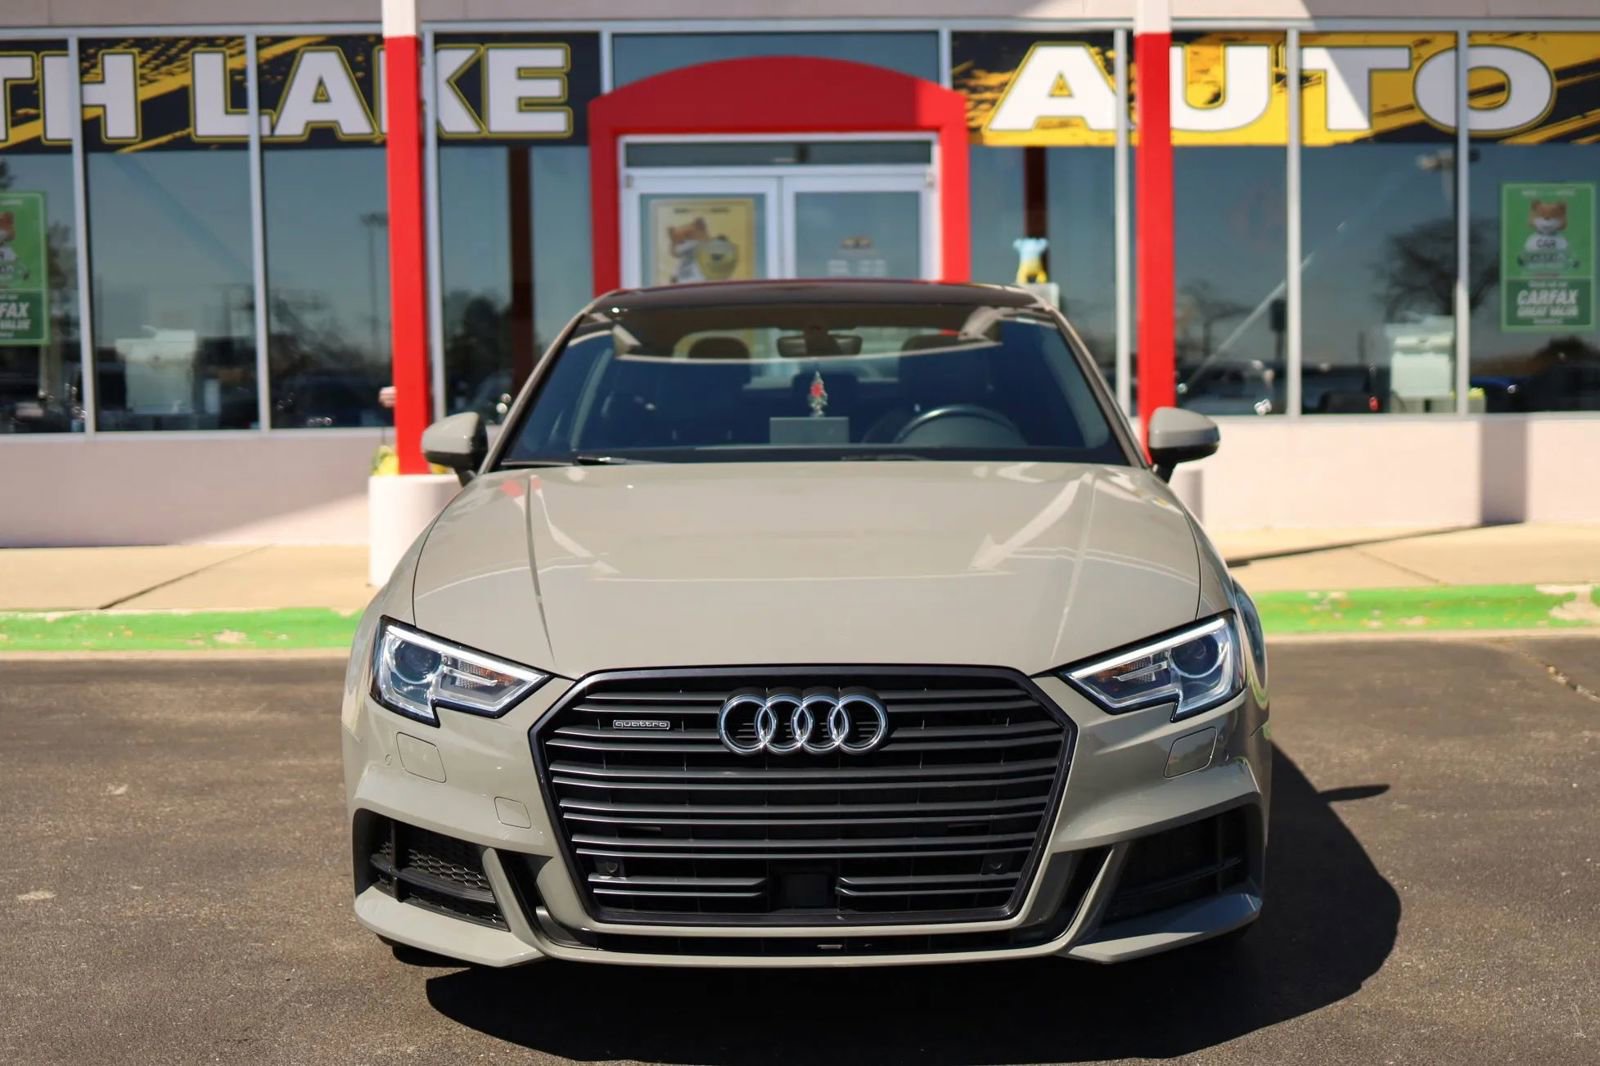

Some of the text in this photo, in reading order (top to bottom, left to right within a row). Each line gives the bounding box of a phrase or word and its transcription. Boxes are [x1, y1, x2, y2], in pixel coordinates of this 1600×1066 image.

[190, 44, 573, 142] LAKE
[981, 41, 1556, 138] AUTO
[1517, 289, 1579, 305] CARFAX
[614, 720, 670, 729] quattro
